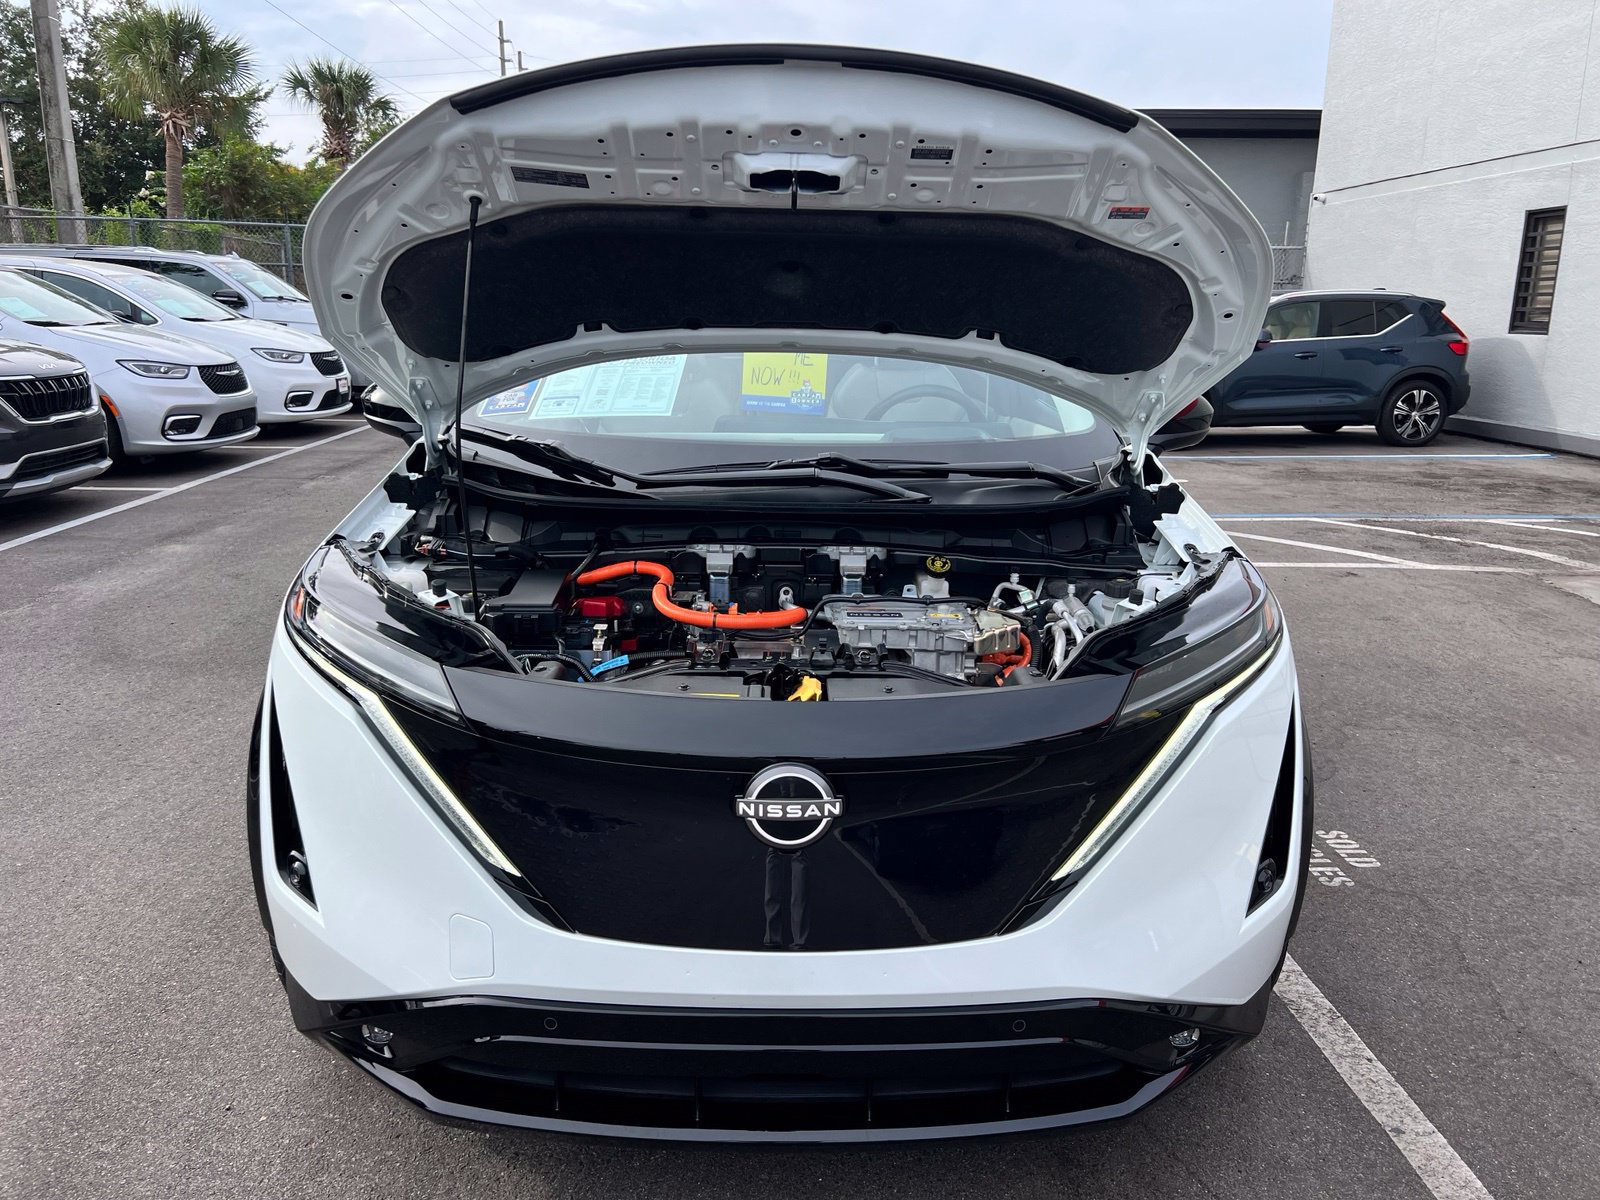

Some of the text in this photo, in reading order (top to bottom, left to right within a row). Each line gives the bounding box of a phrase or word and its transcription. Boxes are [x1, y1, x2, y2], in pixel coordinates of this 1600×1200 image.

[738, 801, 841, 818] NISSAN
[1309, 844, 1355, 887] LES
[1315, 829, 1381, 868] SOLD
